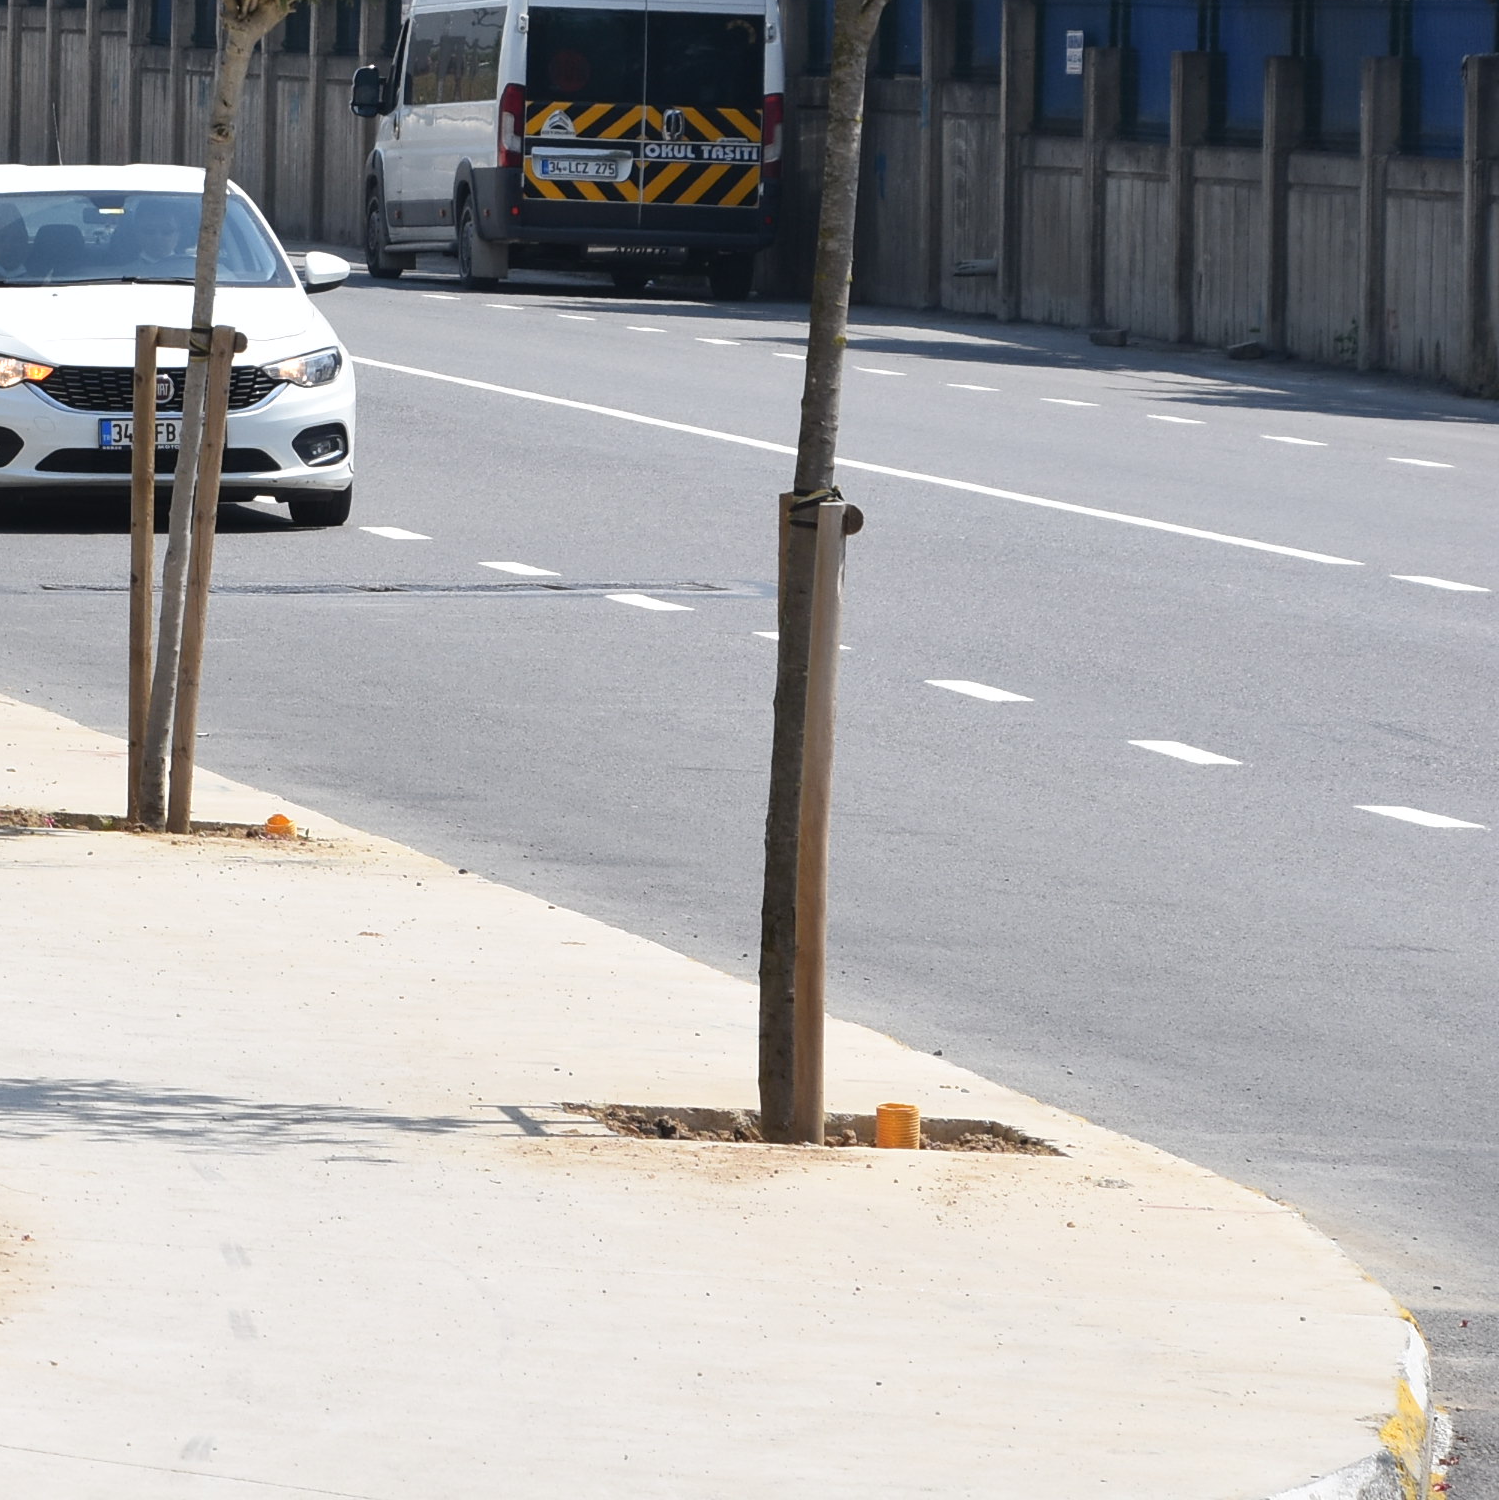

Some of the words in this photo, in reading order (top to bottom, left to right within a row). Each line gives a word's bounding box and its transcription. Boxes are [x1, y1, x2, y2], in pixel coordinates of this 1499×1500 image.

[644, 143, 696, 158] OKUL
[702, 145, 758, 161] TAŞITI
[550, 161, 562, 173] 34
[568, 162, 589, 174] LCZ
[595, 163, 615, 175] 275
[155, 383, 169, 396] IAT
[112, 423, 134, 443] 34
